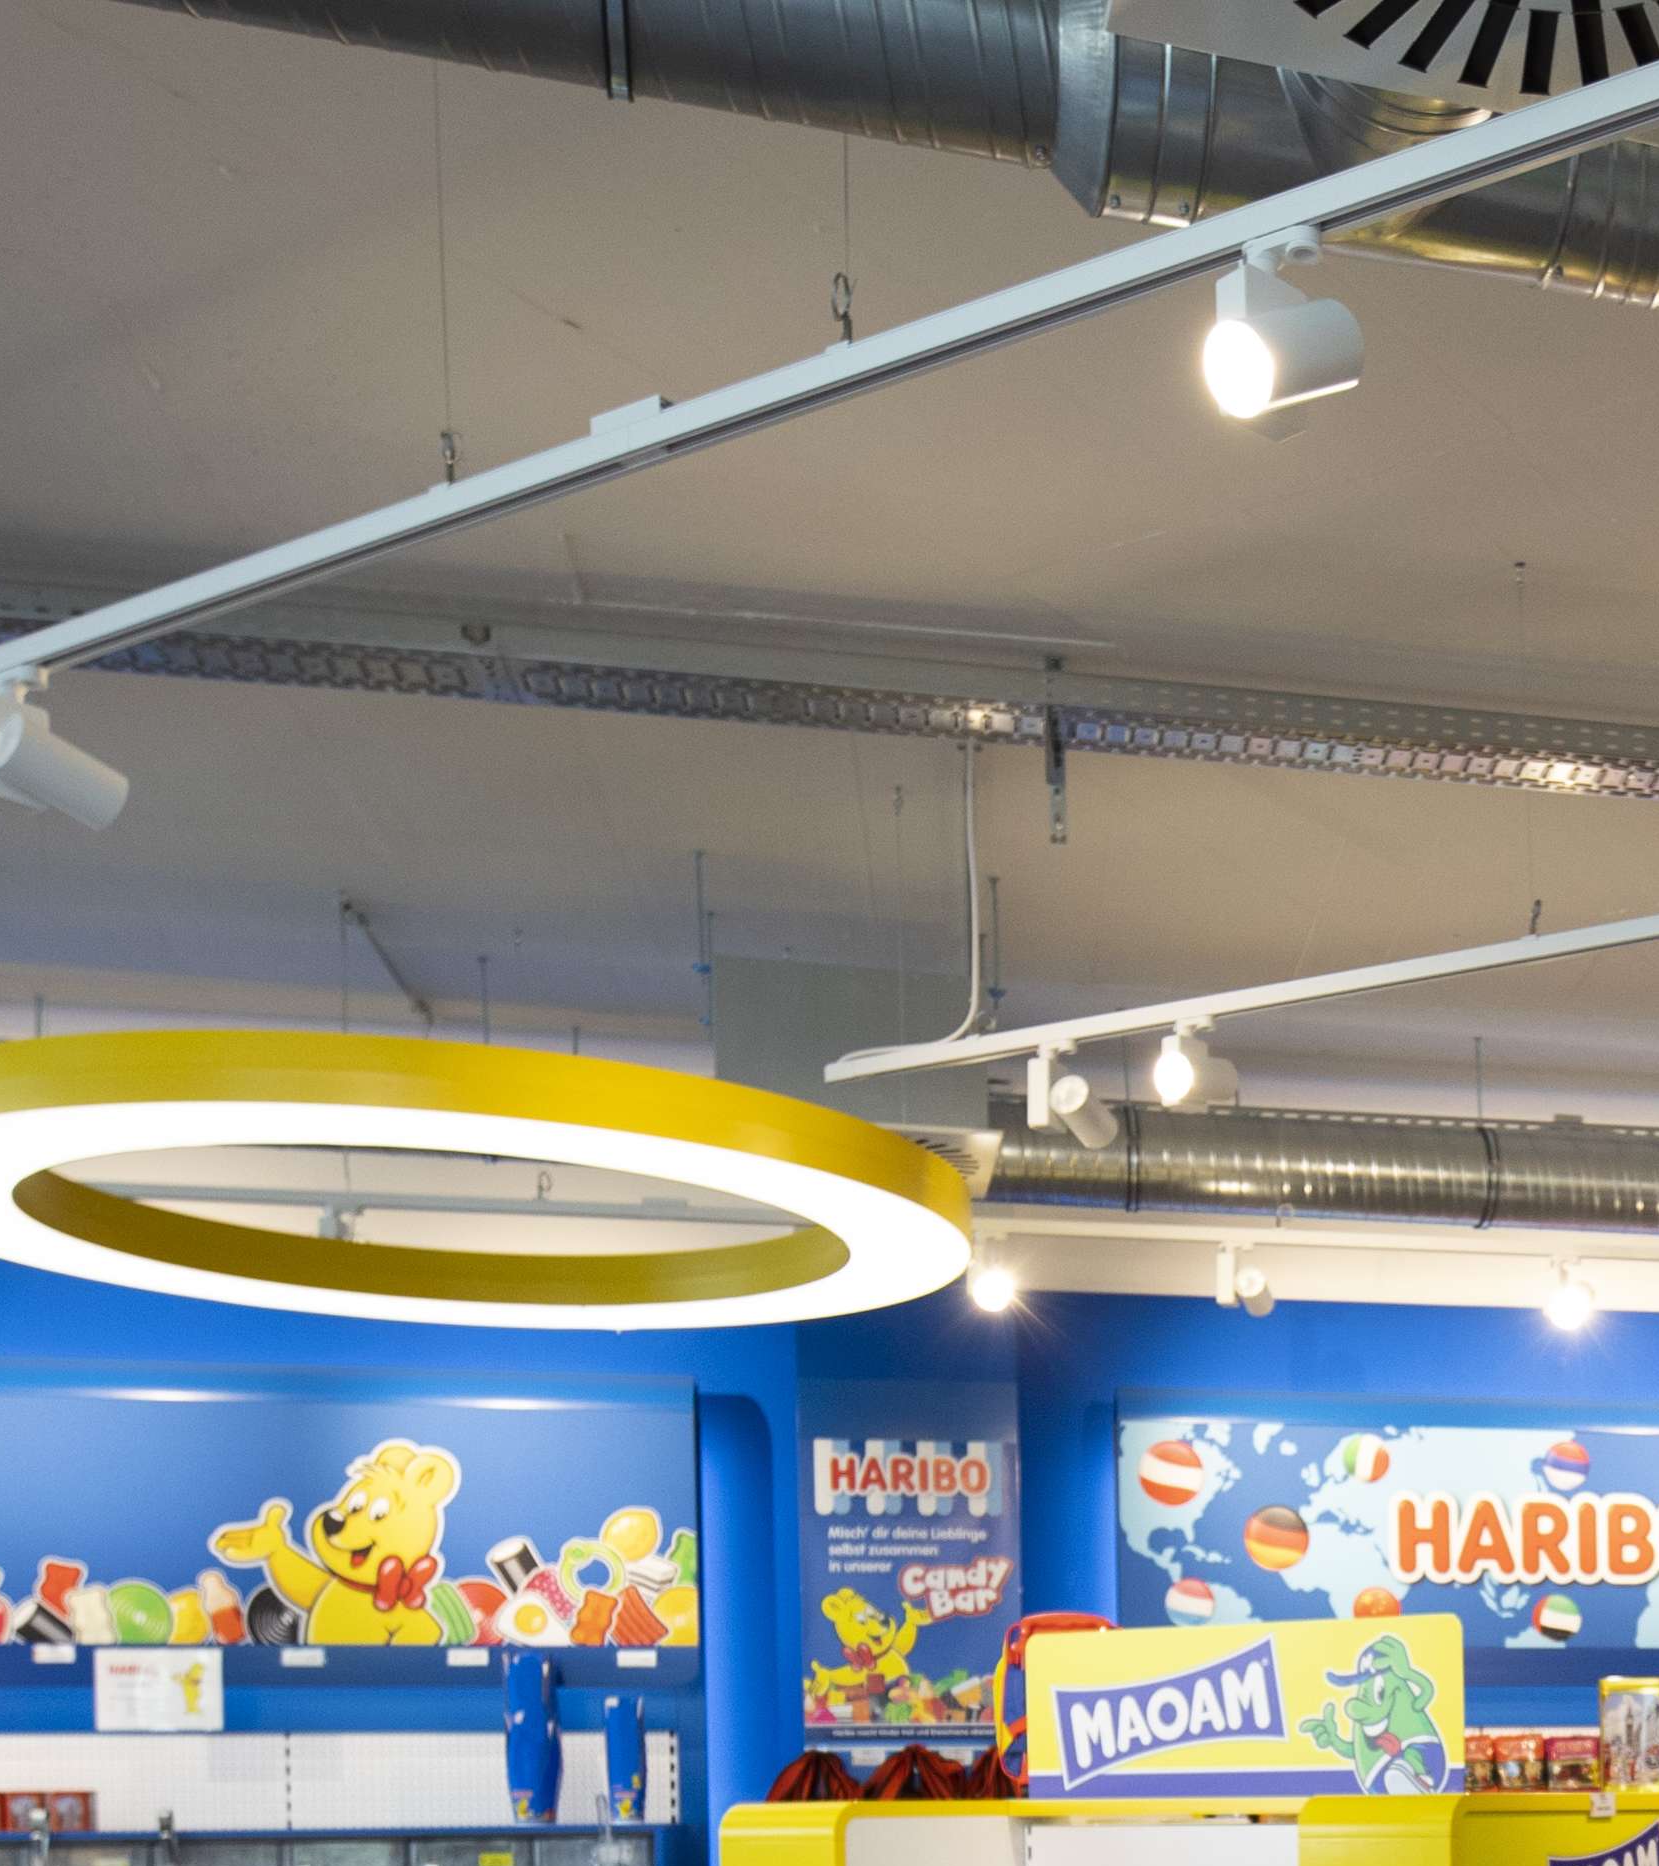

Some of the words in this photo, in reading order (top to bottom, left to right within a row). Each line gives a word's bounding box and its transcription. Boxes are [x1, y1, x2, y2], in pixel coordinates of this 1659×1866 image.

[829, 1457, 988, 1494] HARIBO
[872, 1526, 888, 1539] dir
[892, 1527, 928, 1539] deine
[930, 1527, 986, 1543] Lieblinge
[828, 1543, 864, 1556] selbst
[868, 1545, 939, 1556] zusammen
[828, 1560, 840, 1572] in
[844, 1563, 891, 1572] unserer
[902, 1559, 1009, 1594] Candy
[929, 1589, 998, 1617] Bar
[1066, 1668, 1271, 1770] MAOAM
